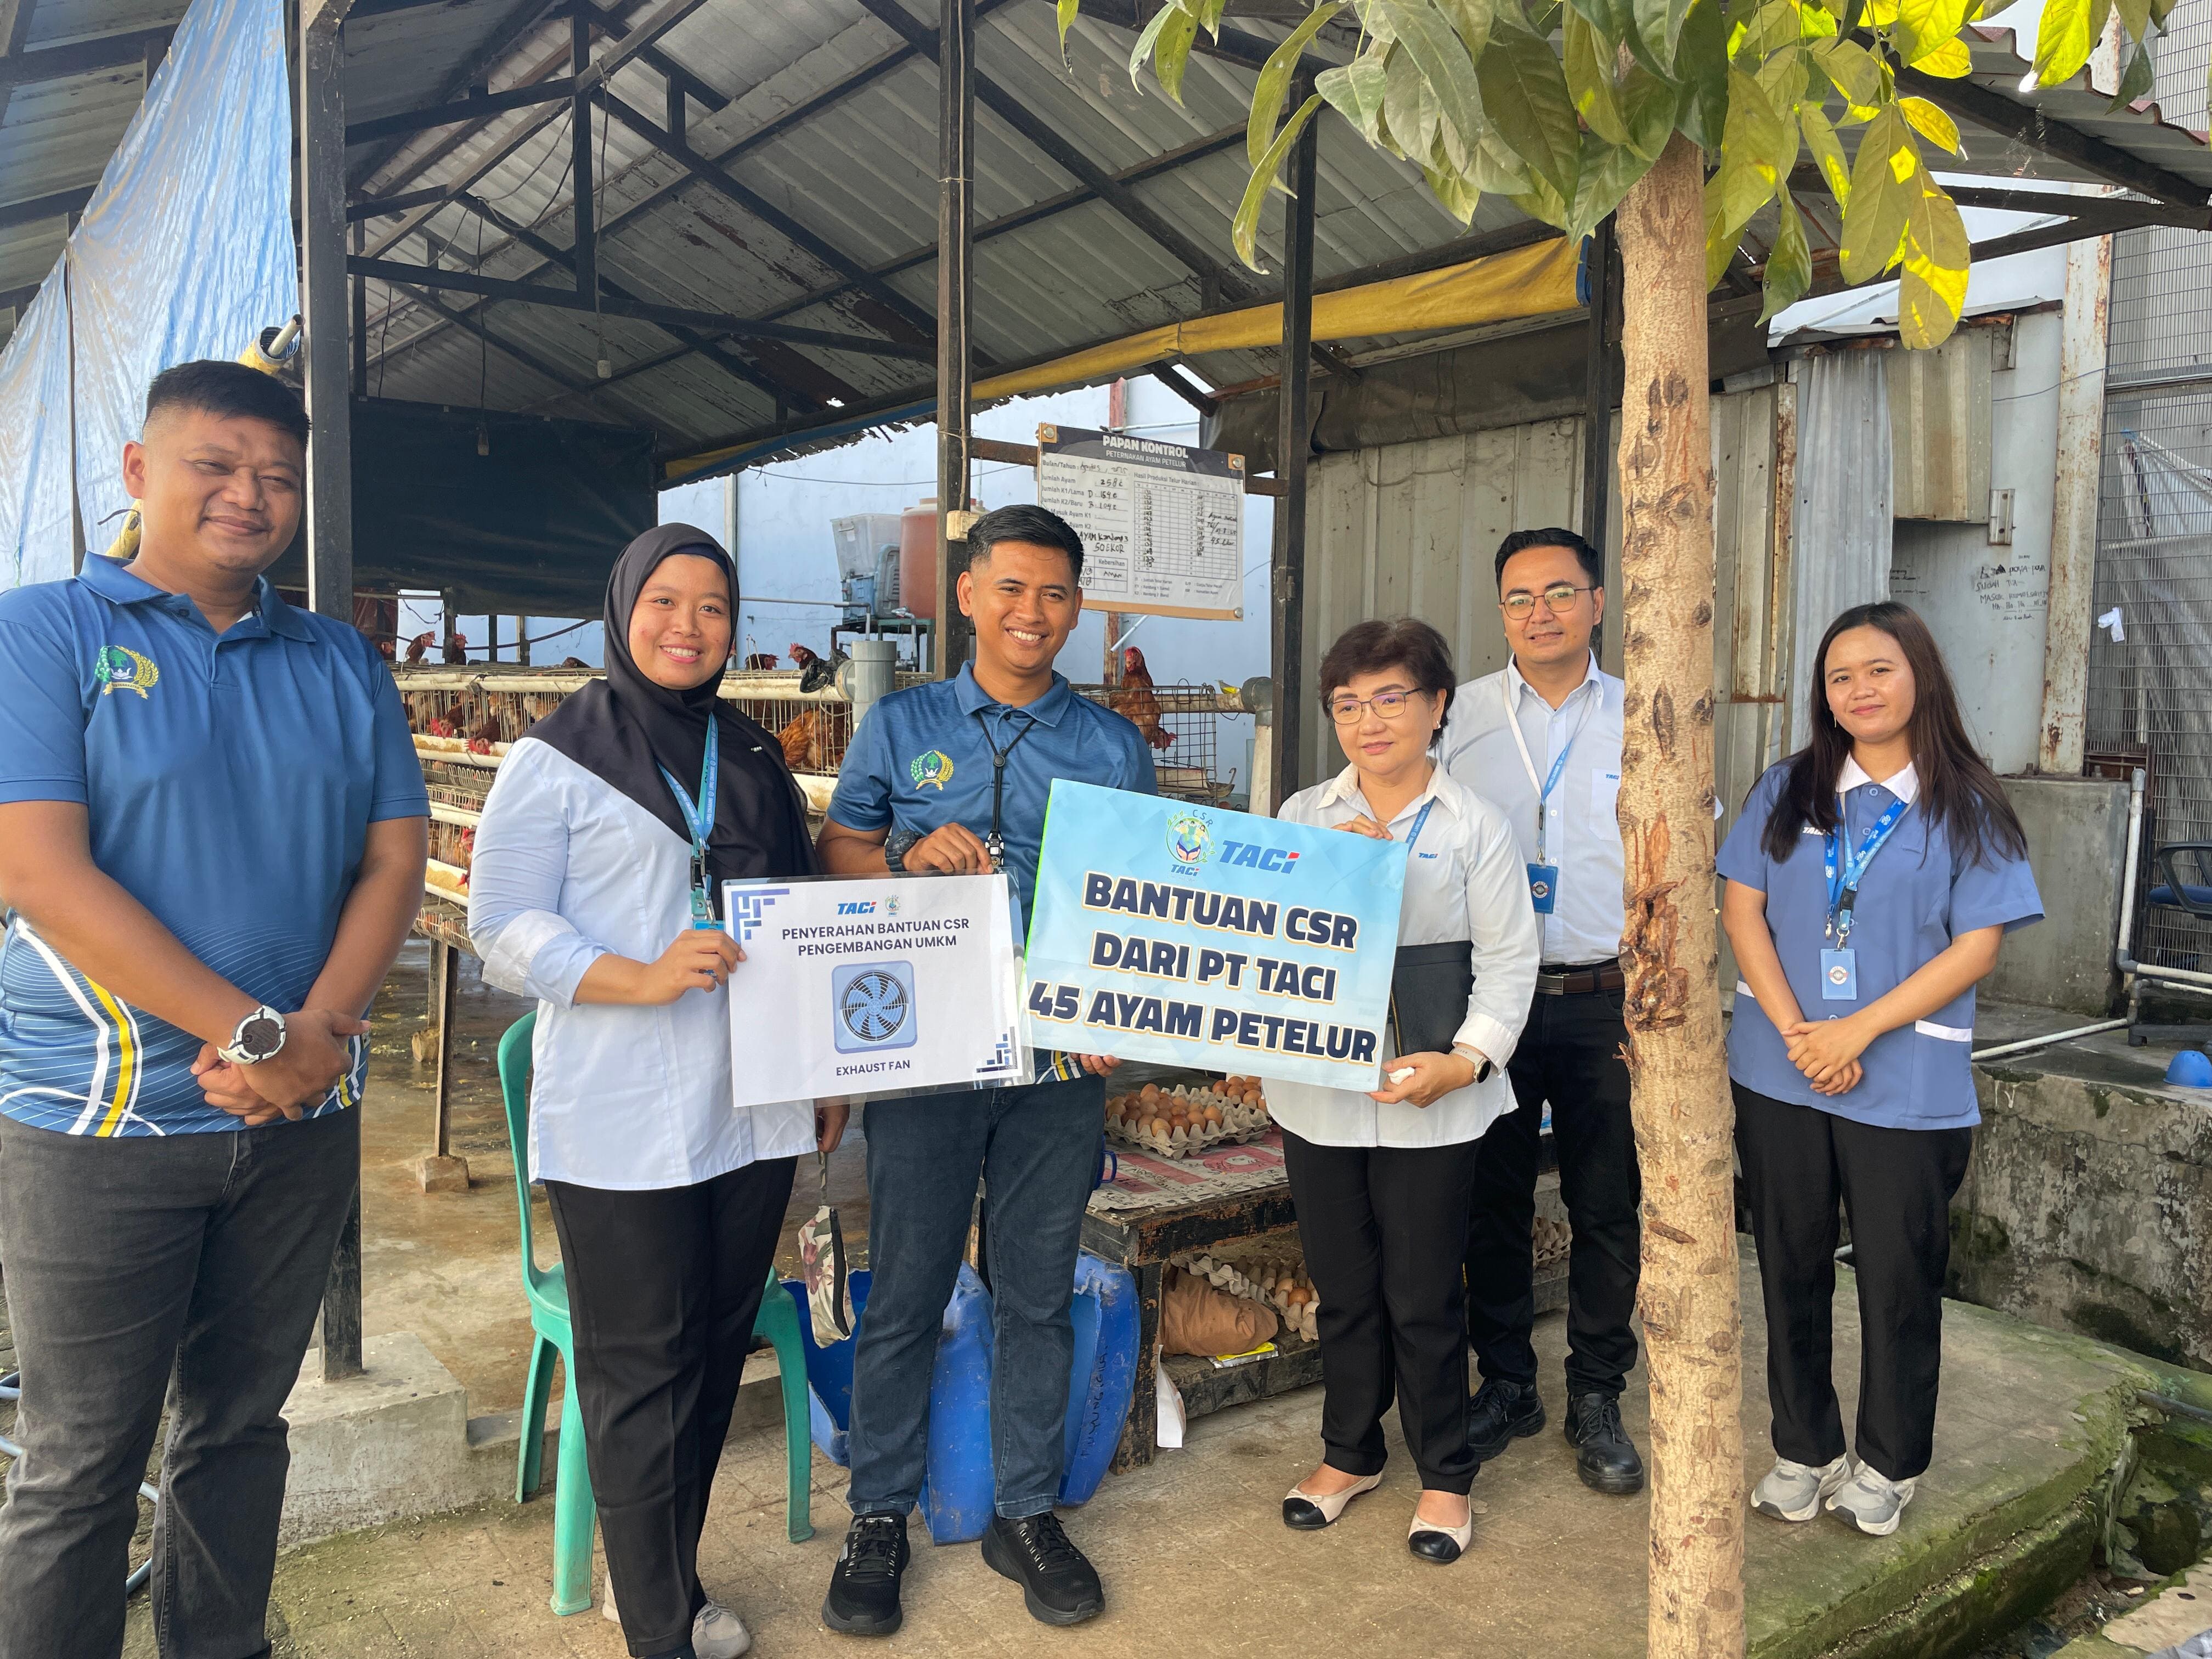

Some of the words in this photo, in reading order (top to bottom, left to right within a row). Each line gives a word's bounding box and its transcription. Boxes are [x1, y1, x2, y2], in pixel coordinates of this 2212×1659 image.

[1102, 435, 1139, 451] PAPAN
[1141, 440, 1188, 459] KONTROL
[1106, 450, 1144, 462] PETERNAKAN
[1145, 455, 1162, 465] AYAM
[1162, 459, 1187, 468] PETELUR
[1147, 474, 1168, 482] Produksi
[1061, 487, 1085, 496] K1/Lama
[1061, 498, 1084, 506] K2/Baru
[1192, 809, 1214, 827] CSR
[1083, 871, 1279, 937] BANTUAN
[1284, 906, 1358, 950] CSR
[782, 922, 874, 940] PENYERAHAN
[877, 920, 941, 934] BANTUAN
[943, 917, 970, 930] CSR
[798, 938, 913, 957] PENGEMBANGAN
[915, 935, 957, 948] UMKM
[1090, 930, 1192, 980] DARI
[1195, 949, 1249, 988] PT
[1254, 957, 1338, 1003] TACI
[1028, 981, 1081, 1022] 45
[1086, 990, 1205, 1039] AYAM
[1210, 1008, 1379, 1063] PETELUR
[836, 1062, 887, 1076] EXHAUST
[888, 1059, 911, 1071] FAN
